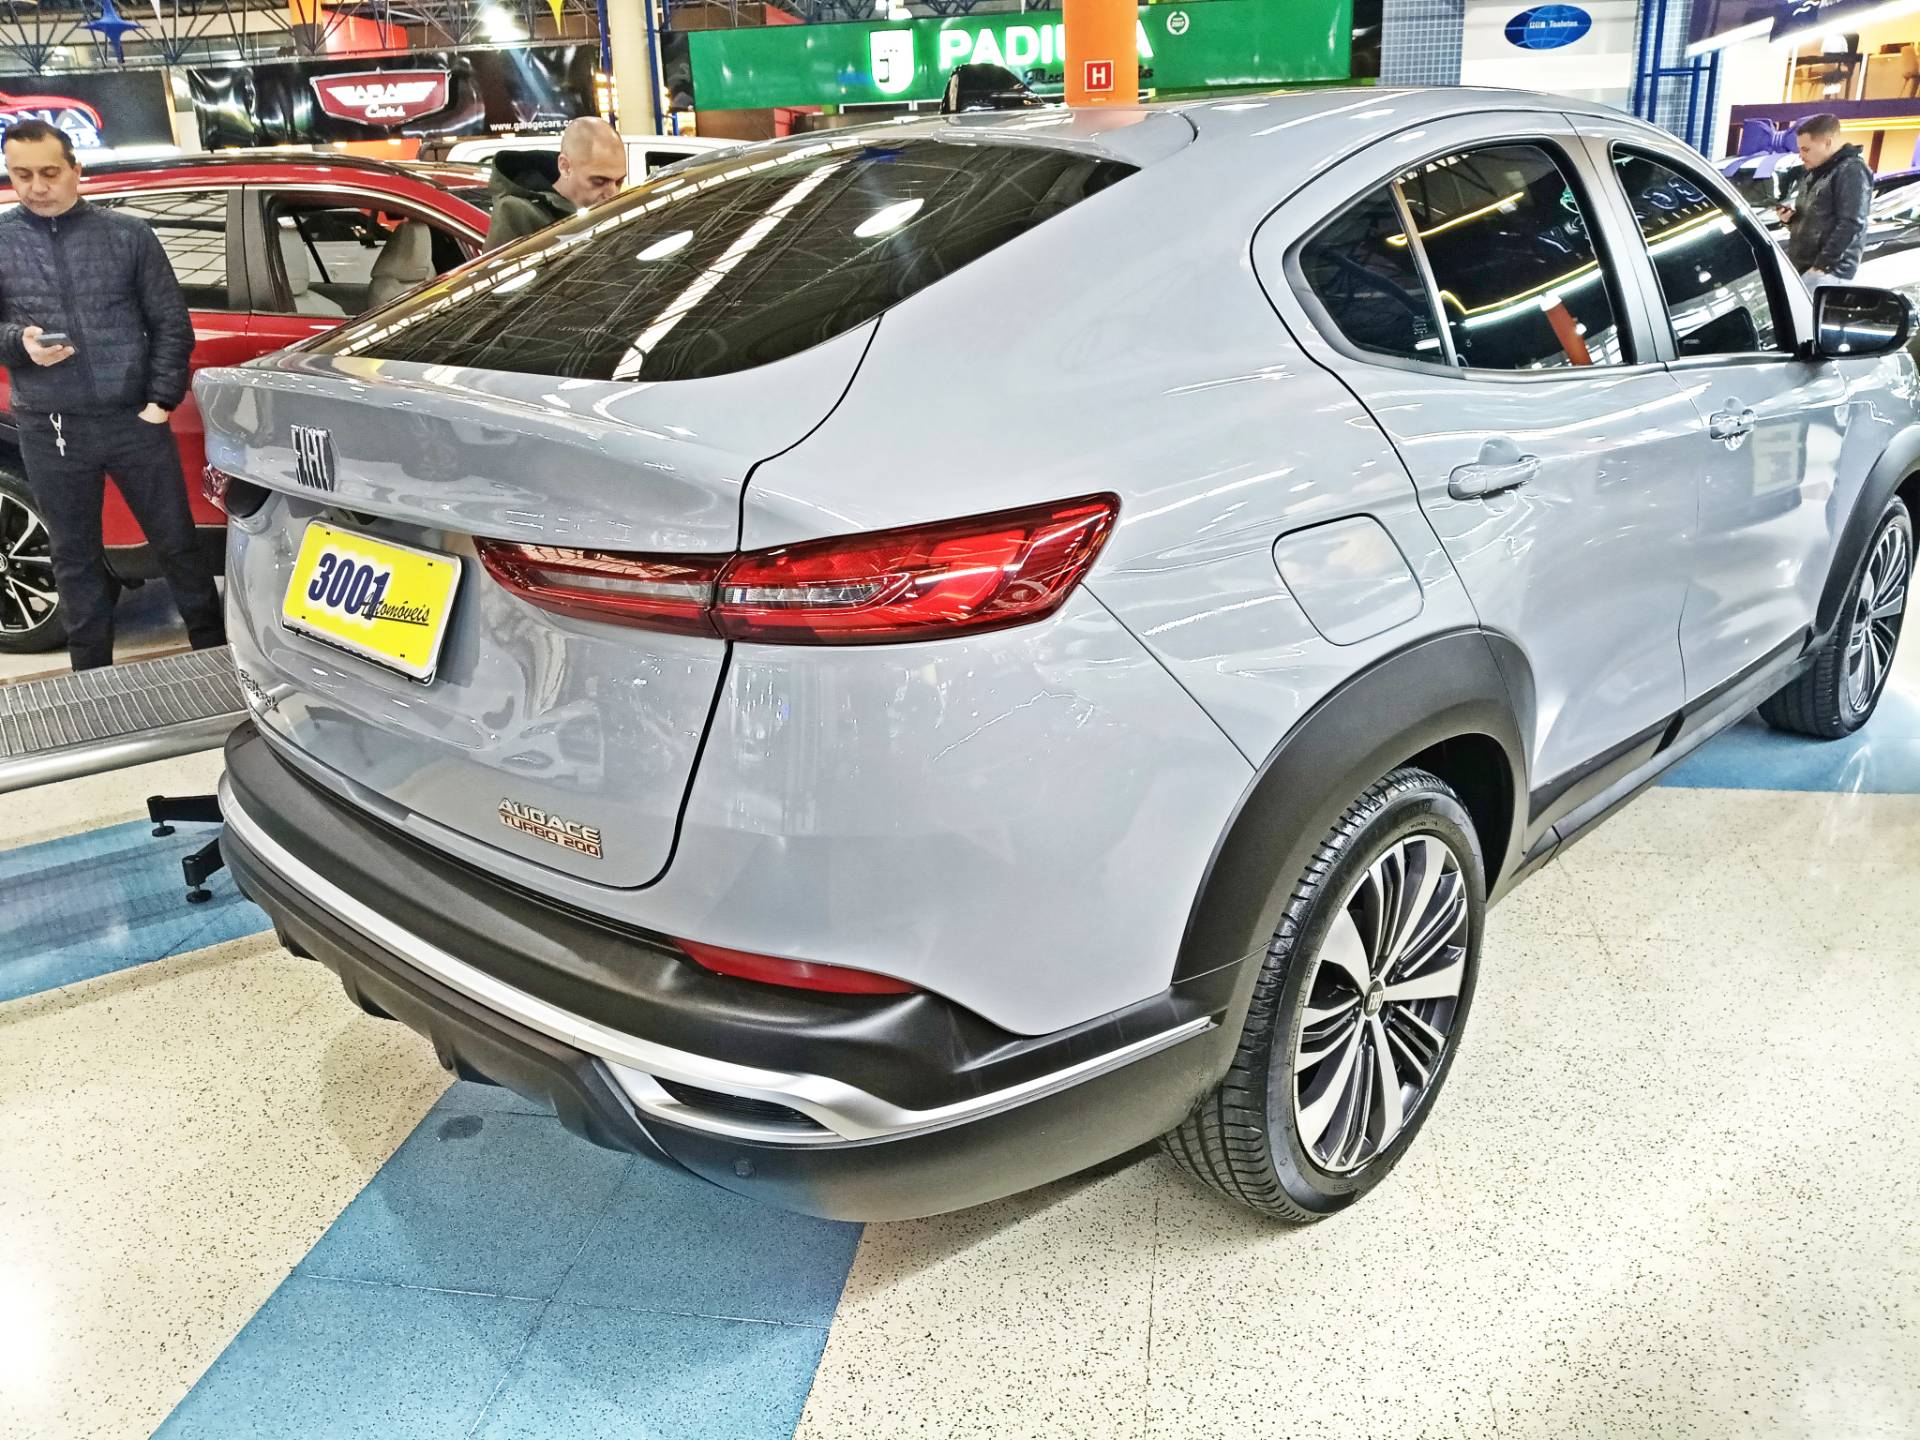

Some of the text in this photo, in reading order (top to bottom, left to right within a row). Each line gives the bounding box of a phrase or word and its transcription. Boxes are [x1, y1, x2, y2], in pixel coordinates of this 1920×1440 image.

[1092, 66, 1106, 86] H
[308, 552, 390, 621] 3001
[499, 798, 601, 843] AUDACE
[500, 812, 601, 858] TURBO 200
